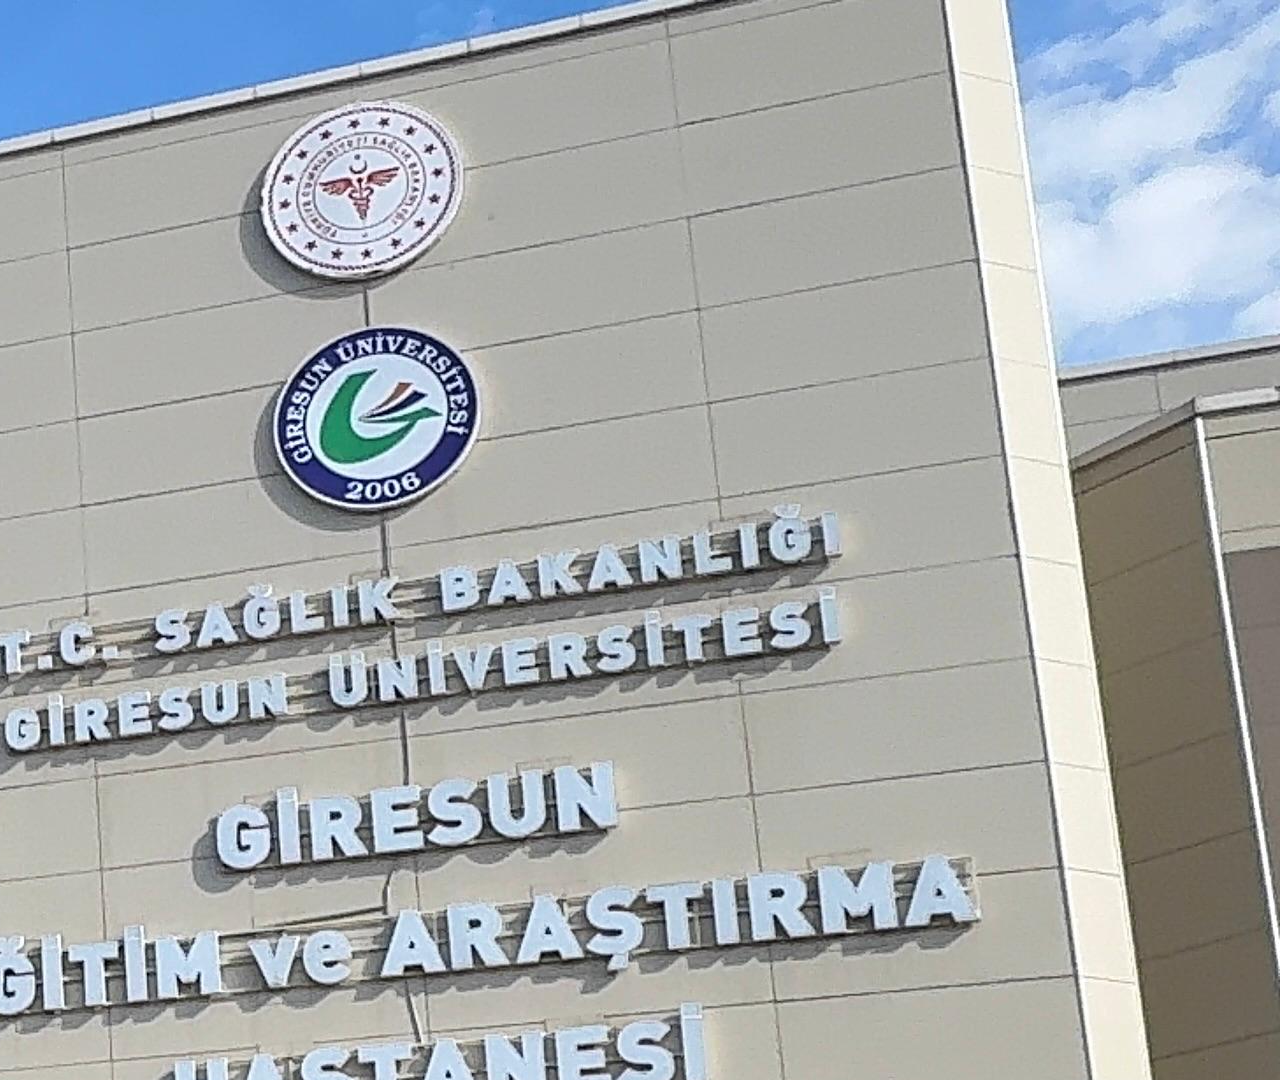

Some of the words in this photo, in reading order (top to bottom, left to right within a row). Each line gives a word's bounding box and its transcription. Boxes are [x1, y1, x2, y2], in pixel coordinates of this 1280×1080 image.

[284, 357, 333, 466] GİRESUN
[337, 331, 470, 437] ÜNİVERSİTESİ
[344, 470, 422, 501] 2006
[154, 575, 401, 654] SAĞLIK
[439, 503, 842, 612] BAKANLIĞI
[4, 672, 289, 752] GİRESUN
[328, 585, 842, 708] ÜNİVERSİTESİ
[215, 759, 620, 871] GİRESUN
[248, 928, 354, 988] ve
[380, 852, 983, 971] ARAŞTIRMA
